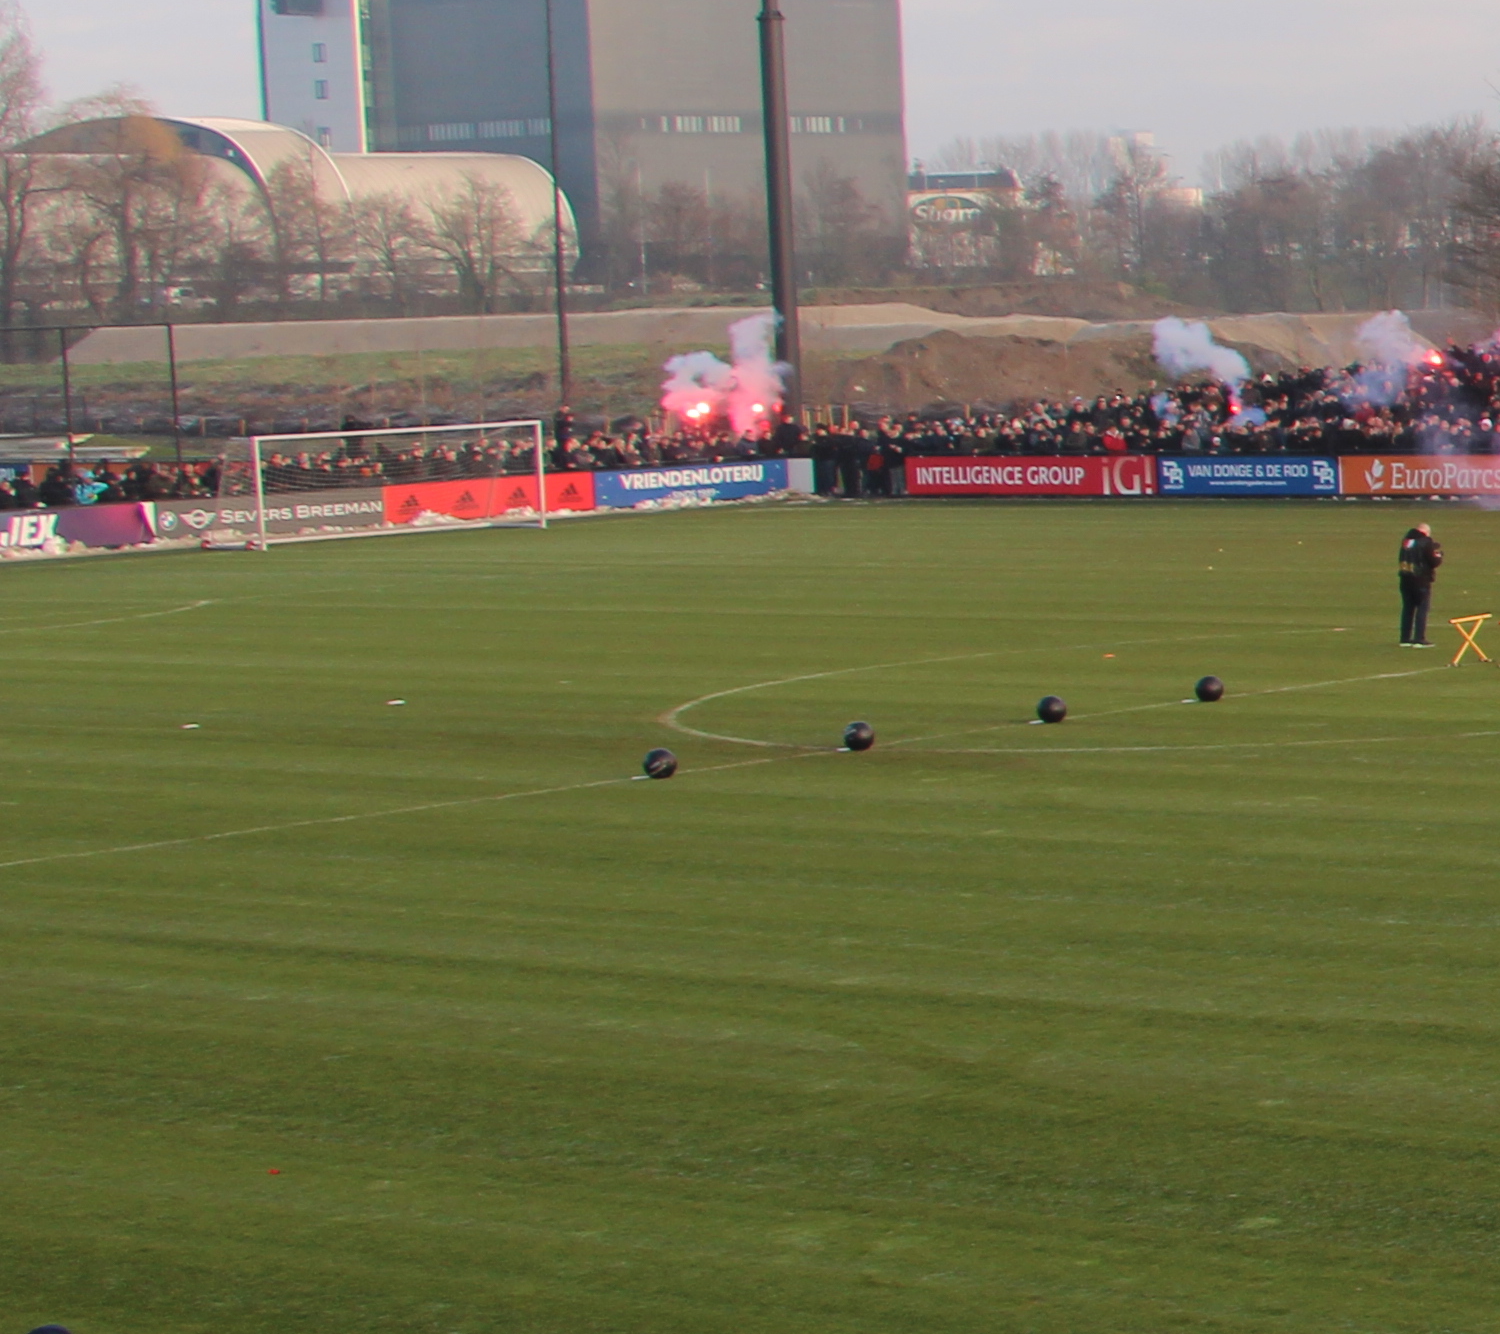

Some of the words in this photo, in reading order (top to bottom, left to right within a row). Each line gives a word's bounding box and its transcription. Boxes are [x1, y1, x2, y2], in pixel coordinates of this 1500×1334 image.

[620, 464, 765, 490] VRIENDENLOTERIJ
[916, 466, 1023, 485] INTELLIGENCE
[1026, 466, 1086, 485] GROUP
[1188, 464, 1212, 478] VAN
[1214, 464, 1253, 478] DONGE
[1255, 464, 1264, 478] &
[1266, 464, 1281, 478] DE
[1284, 464, 1309, 478] ROO
[219, 507, 292, 525] SEVERS
[295, 500, 383, 519] BREEMAN
